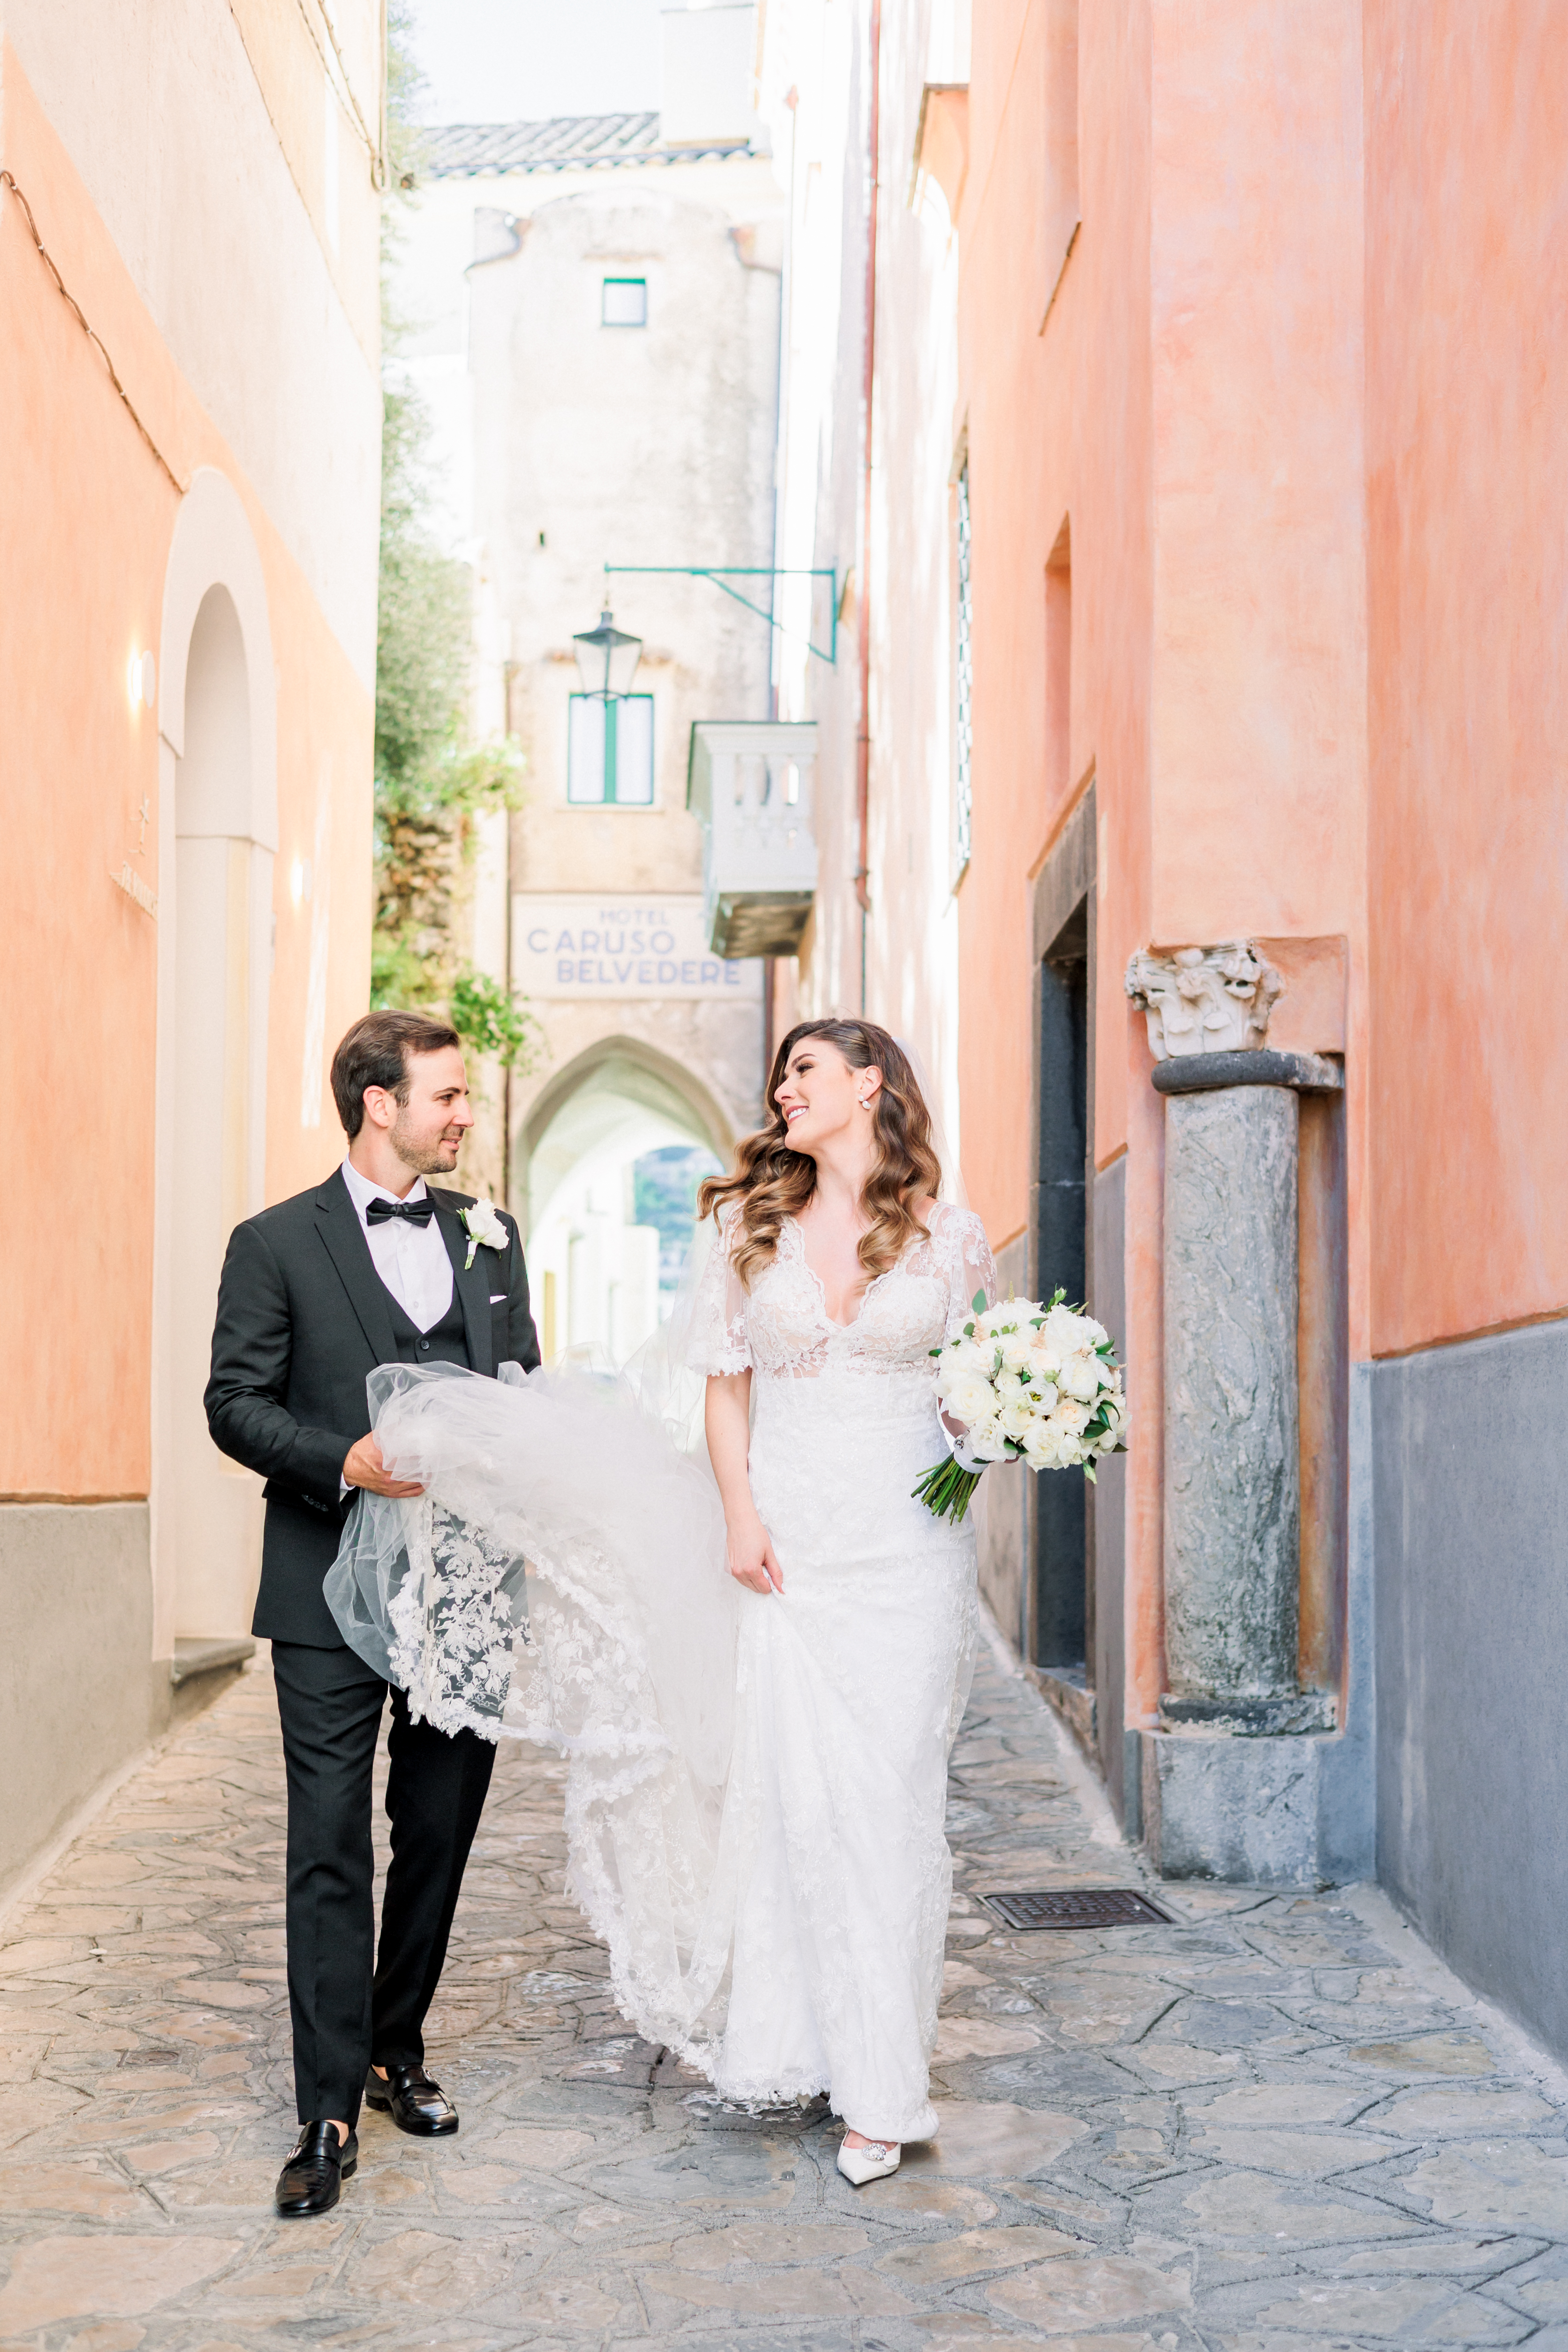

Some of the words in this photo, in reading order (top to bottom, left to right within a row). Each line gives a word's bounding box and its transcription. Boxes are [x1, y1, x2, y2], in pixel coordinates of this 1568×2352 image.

[600, 910, 668, 925] HOTEL
[528, 929, 675, 955] CARUSO
[557, 959, 741, 984] BELVEDERE
